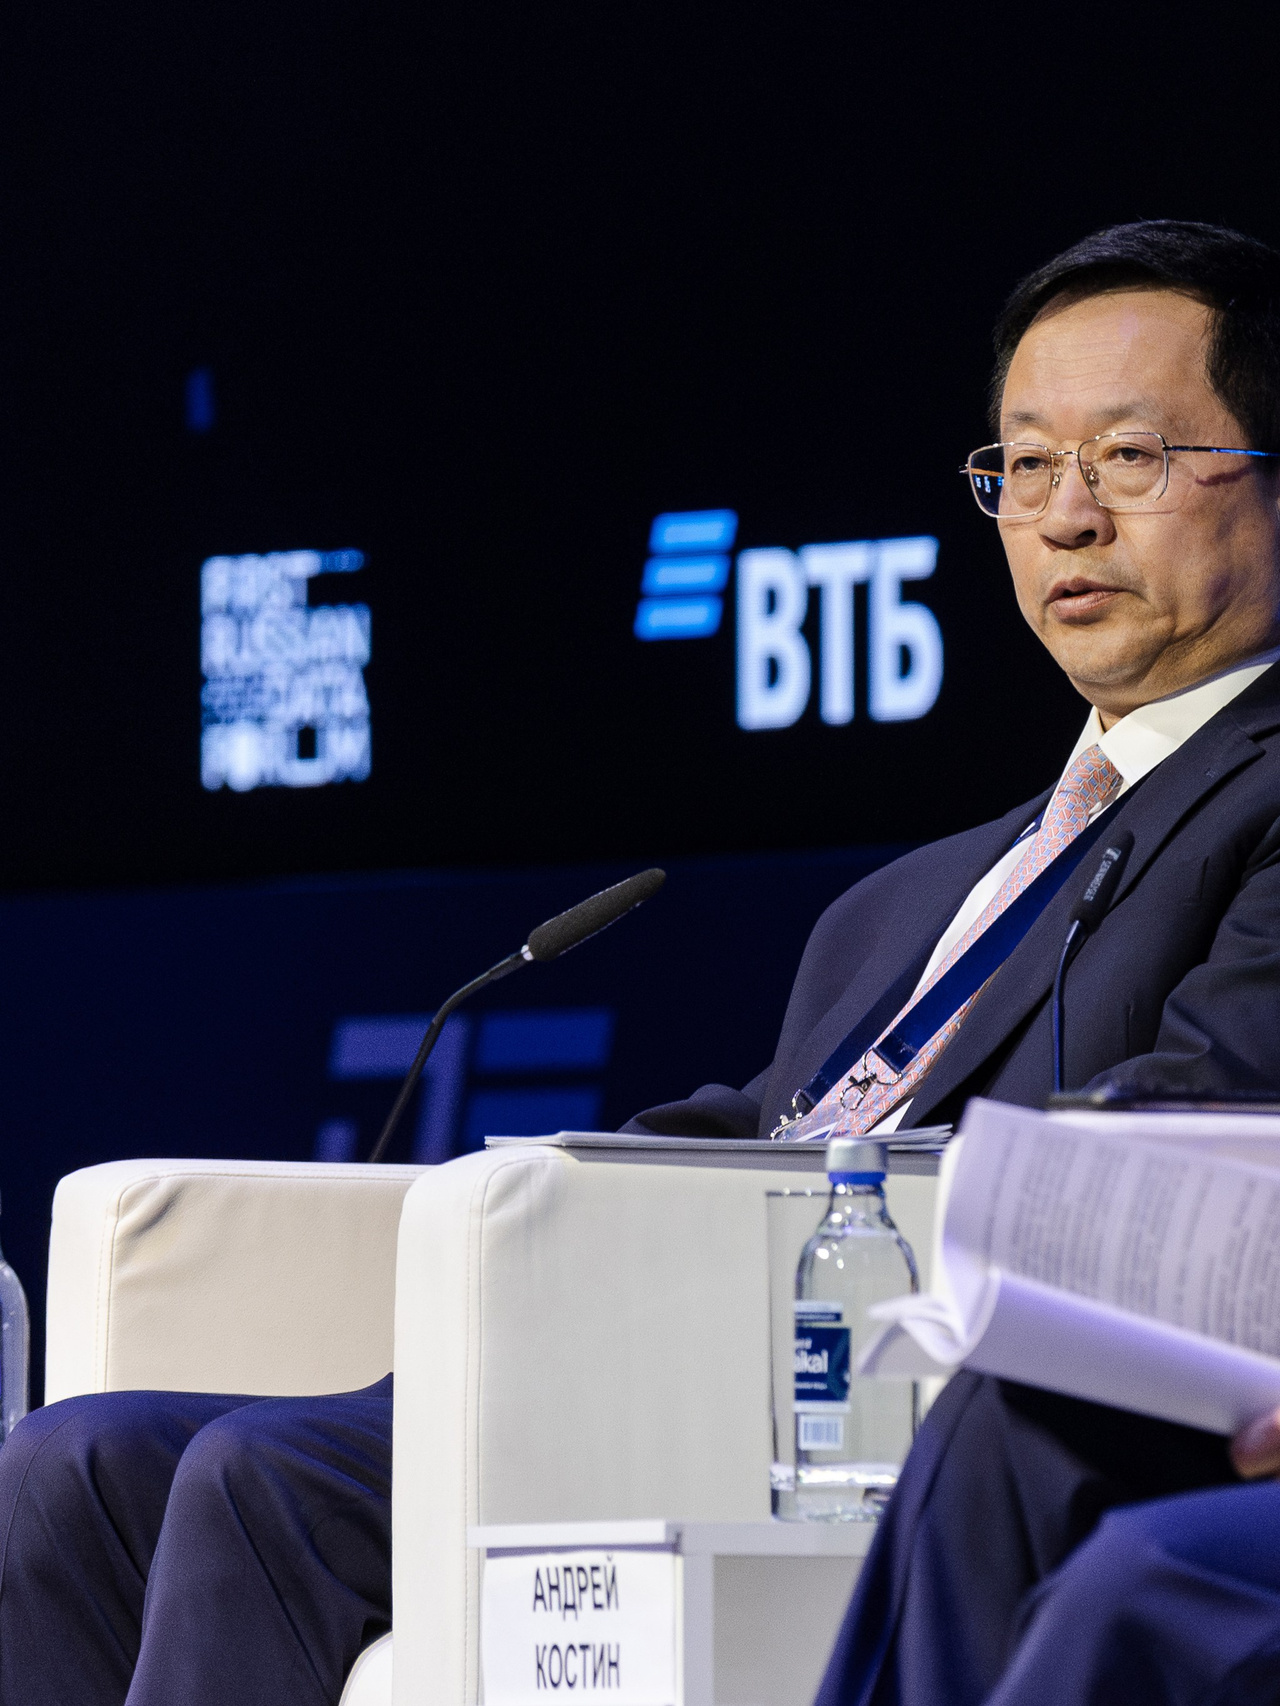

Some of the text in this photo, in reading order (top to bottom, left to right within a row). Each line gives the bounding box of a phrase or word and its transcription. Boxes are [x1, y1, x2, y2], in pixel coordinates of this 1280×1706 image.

[737, 535, 944, 731] ВТБ
[533, 1554, 619, 1621] АНДРЕЙ
[536, 1643, 620, 1689] КОСТИН
